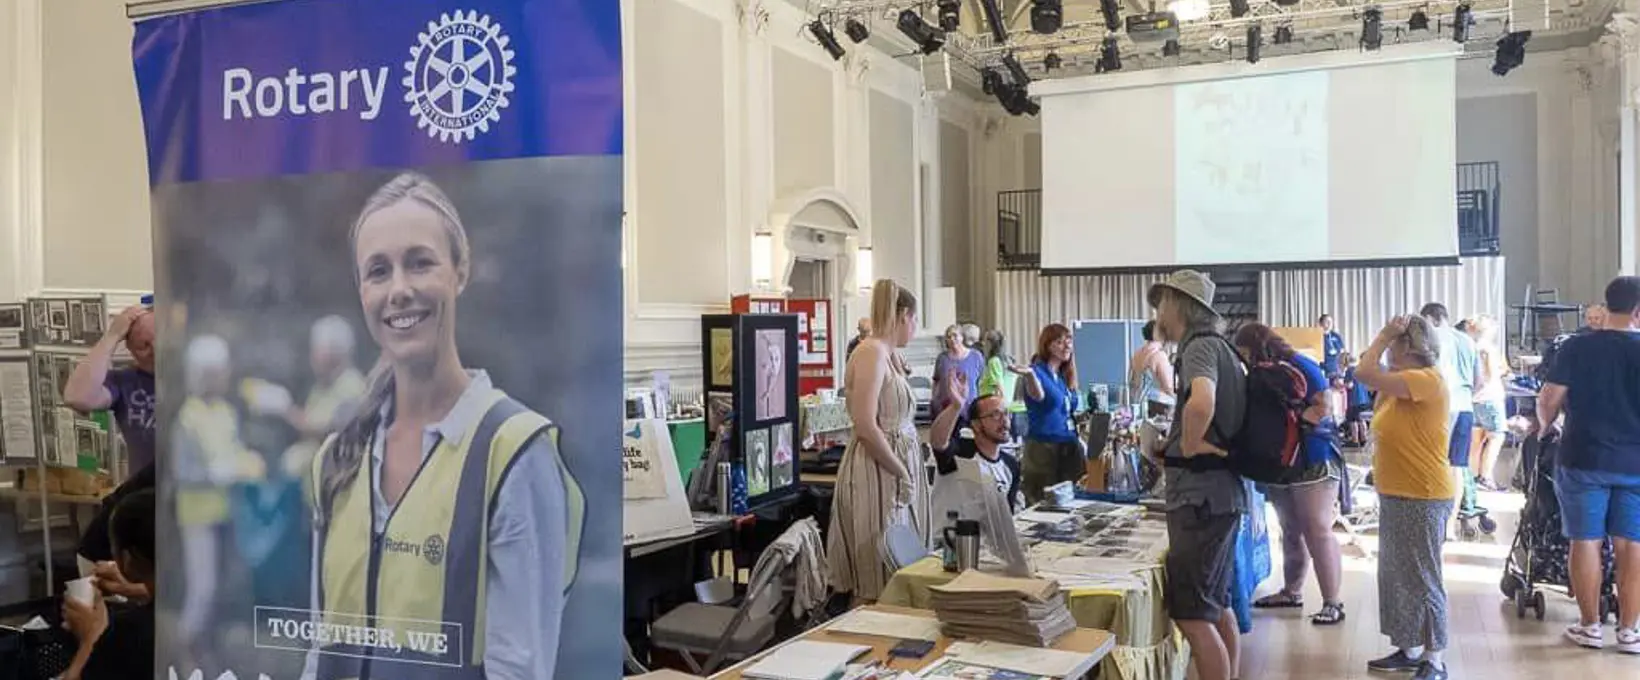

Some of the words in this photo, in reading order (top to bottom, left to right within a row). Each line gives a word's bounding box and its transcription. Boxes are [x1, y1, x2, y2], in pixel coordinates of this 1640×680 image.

[434, 25, 482, 42] ROTARY
[223, 66, 389, 120] Rotary
[420, 90, 500, 128] INTERNATIONAL
[386, 537, 420, 556] Rotary
[268, 618, 402, 652] TOGETHER,
[406, 631, 448, 654] WE
